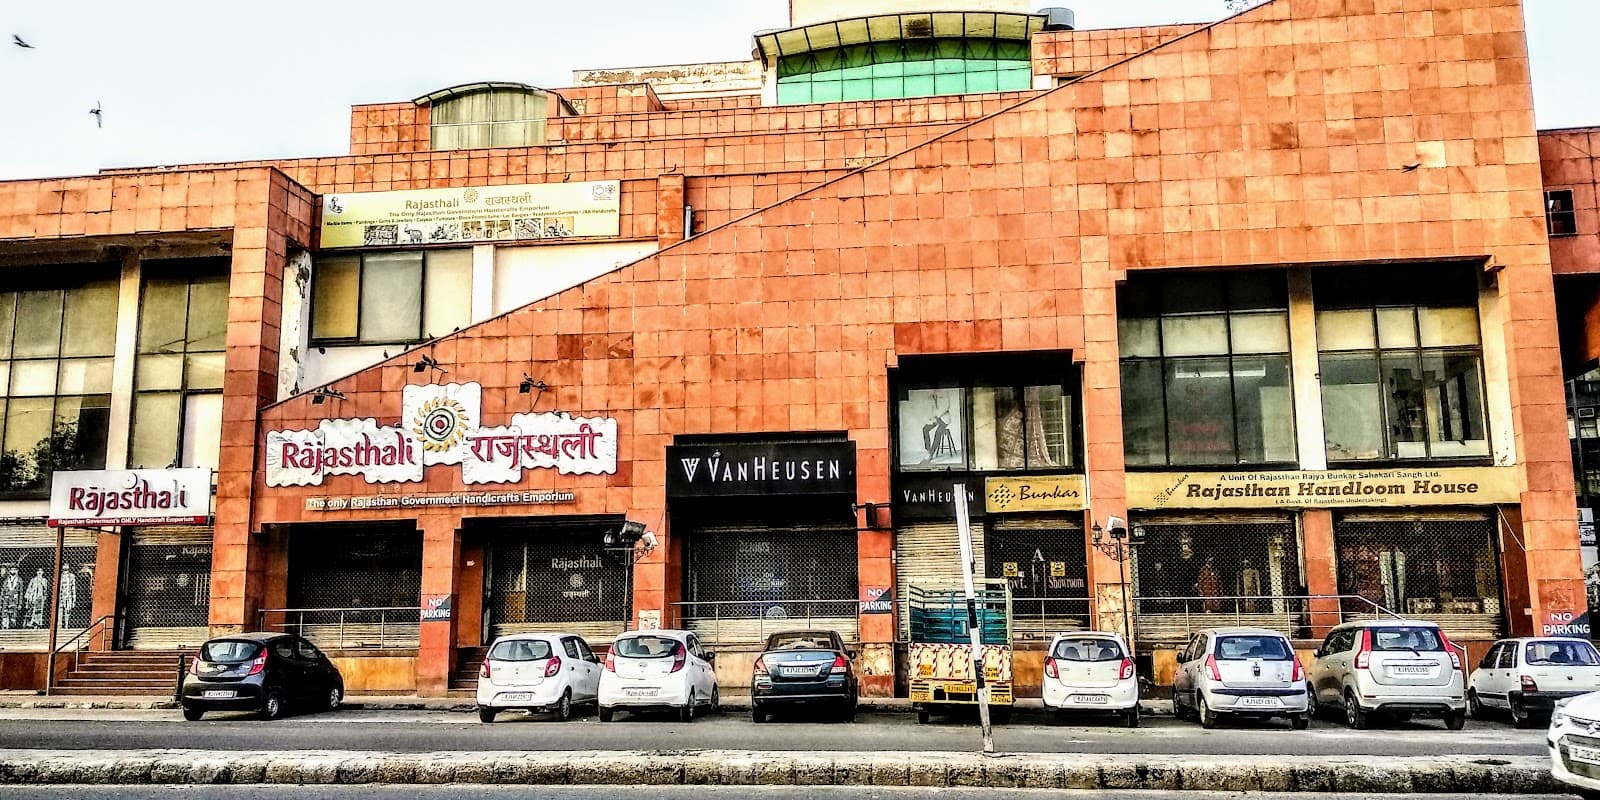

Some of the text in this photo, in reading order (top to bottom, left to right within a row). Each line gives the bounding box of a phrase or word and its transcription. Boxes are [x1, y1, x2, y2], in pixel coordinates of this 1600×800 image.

[405, 198, 459, 212] Rajasthali
[466, 423, 603, 469] राजस्थली
[1229, 473, 1245, 481] Unit
[1260, 473, 1300, 482] Rajasthan
[1327, 472, 1356, 480] Bunkar
[1397, 471, 1423, 480] Sangh
[1425, 471, 1441, 479] Ltd.
[904, 489, 975, 503] VANHEUN
[1018, 485, 1080, 500] Bunkar
[1186, 480, 1479, 501] Rajasthan Handloom House
[308, 491, 574, 509] The only Rajasthan Government Handicrafts Emporium
[867, 589, 883, 597] NO
[428, 598, 443, 606] NO
[860, 601, 892, 611] PARKING
[421, 609, 450, 618] PARKING
[1550, 612, 1573, 621] NO
[1543, 624, 1591, 634] PARKING
